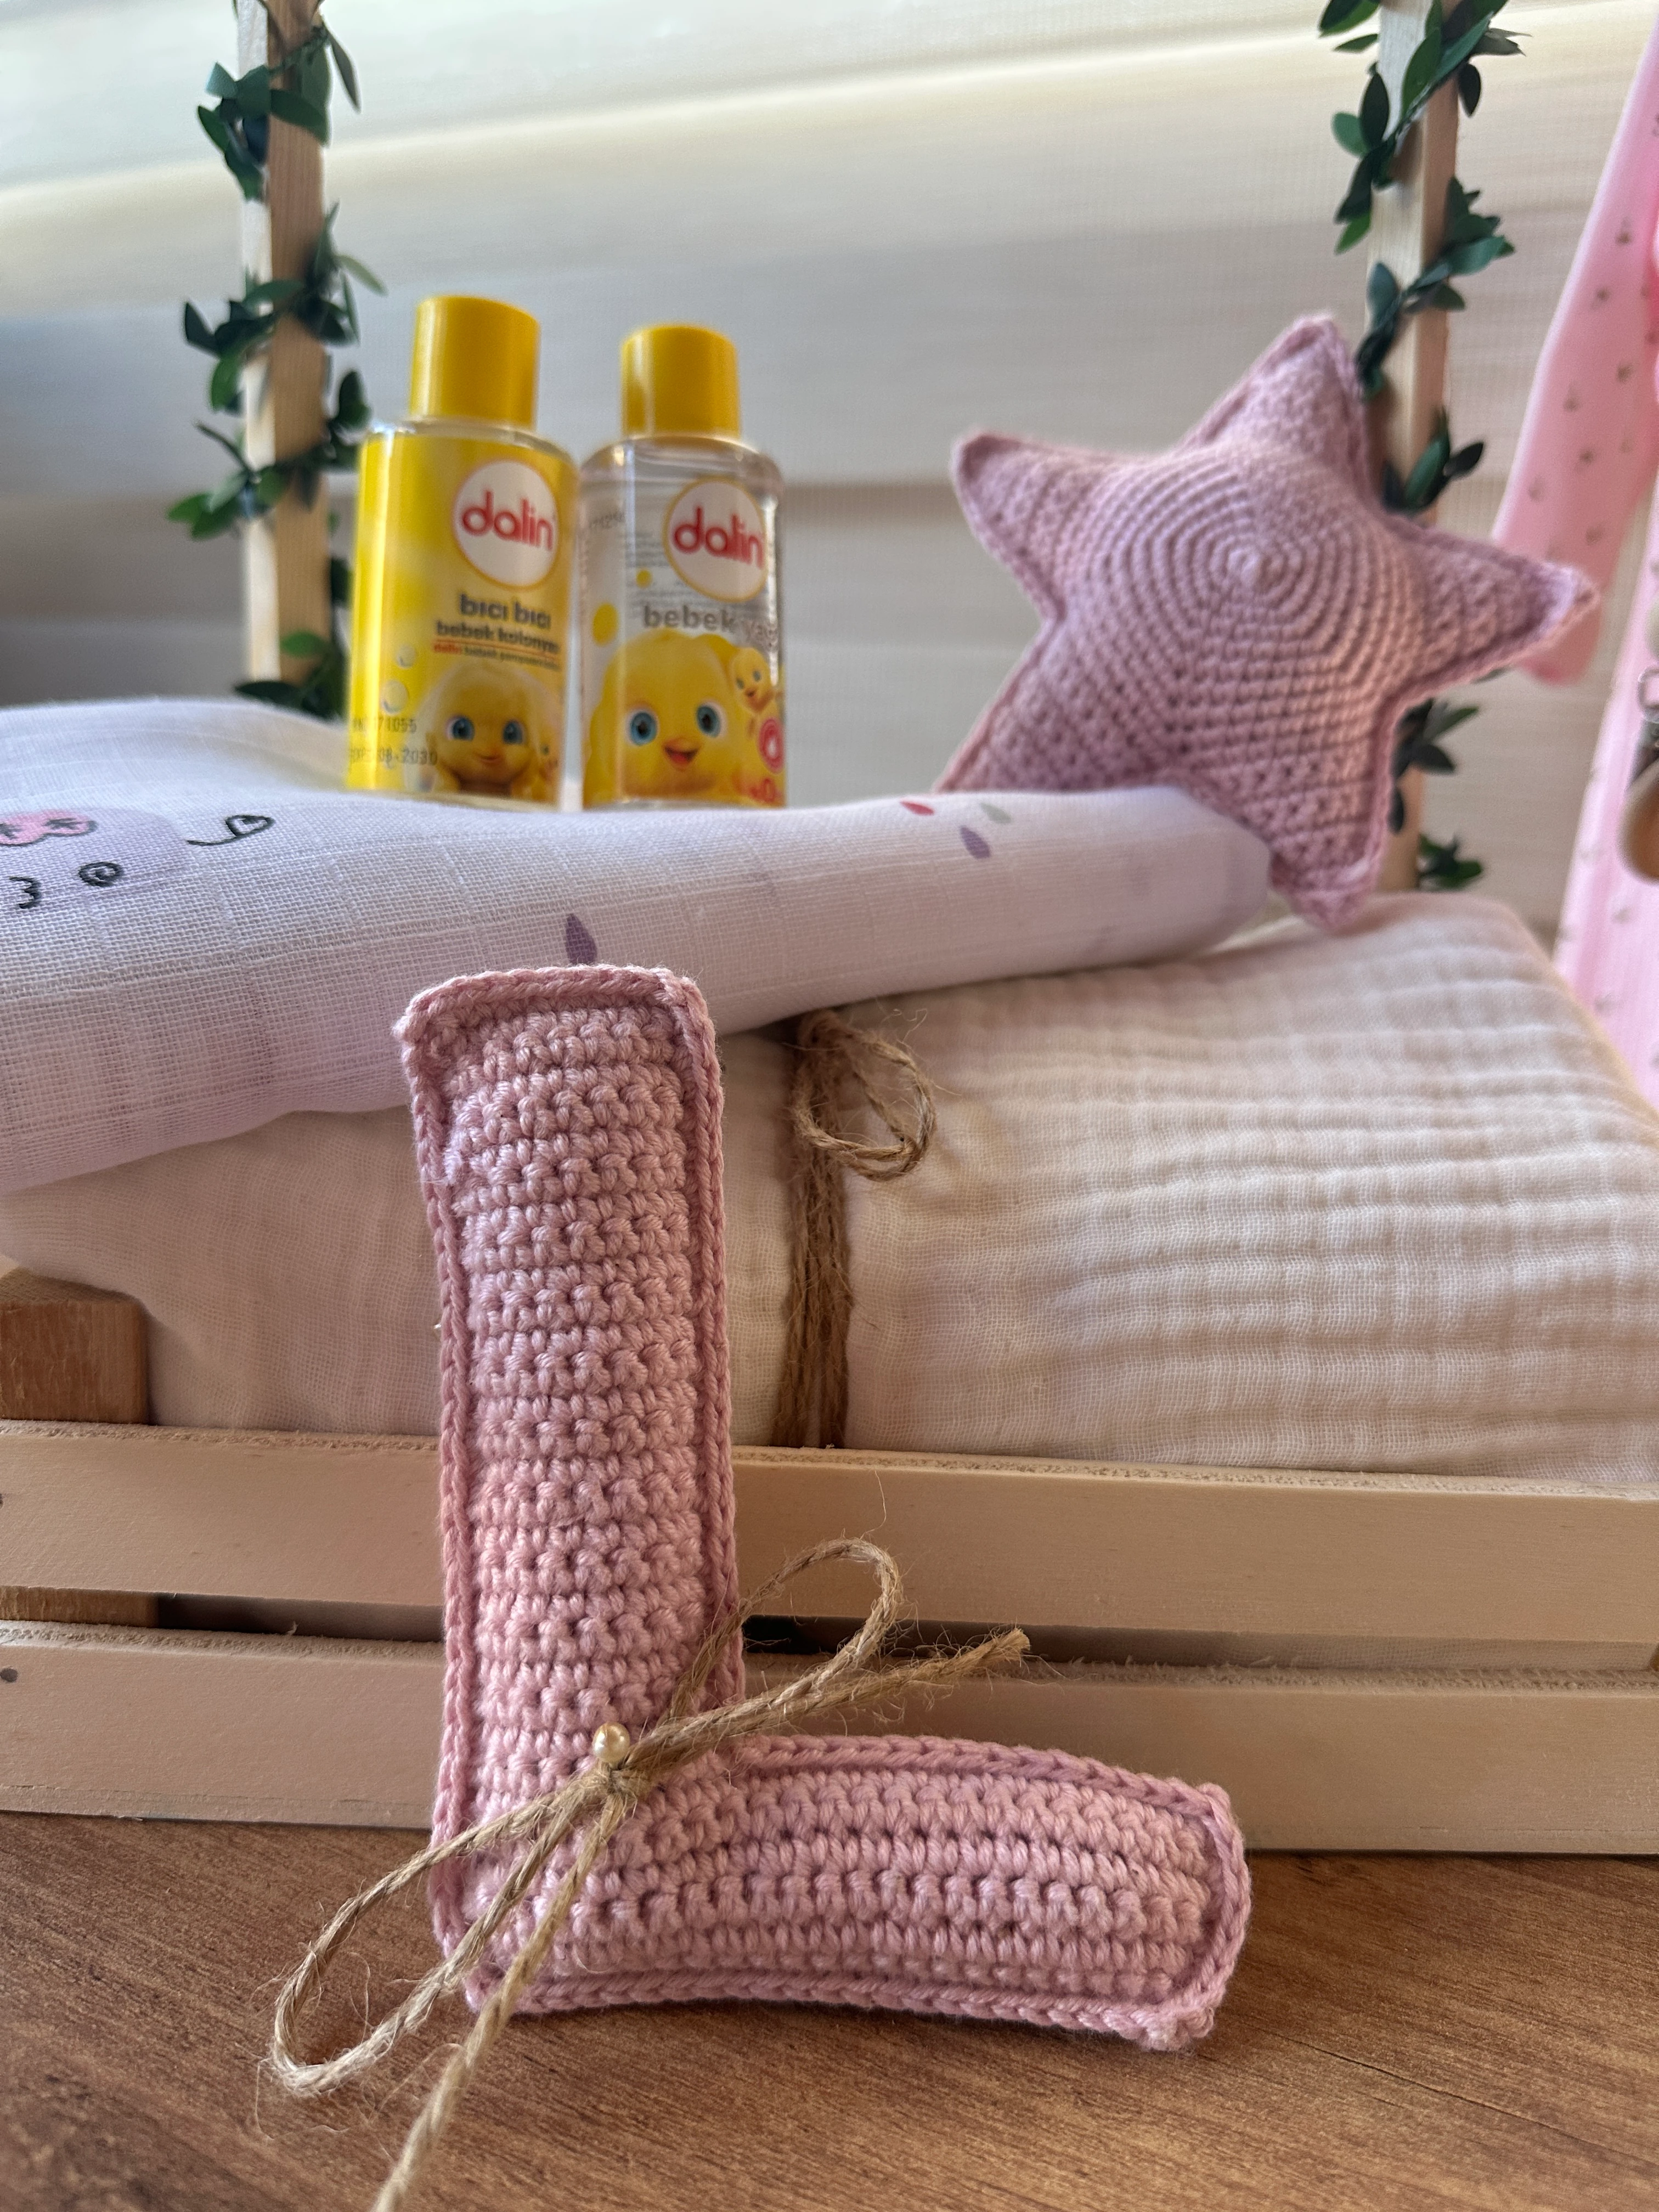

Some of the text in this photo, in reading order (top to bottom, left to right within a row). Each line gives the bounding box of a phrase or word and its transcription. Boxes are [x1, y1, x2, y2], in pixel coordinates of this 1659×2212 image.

[462, 490, 554, 552] dalin
[673, 505, 765, 570] dalin
[436, 620, 494, 640] bebek
[644, 605, 735, 633] bebek
